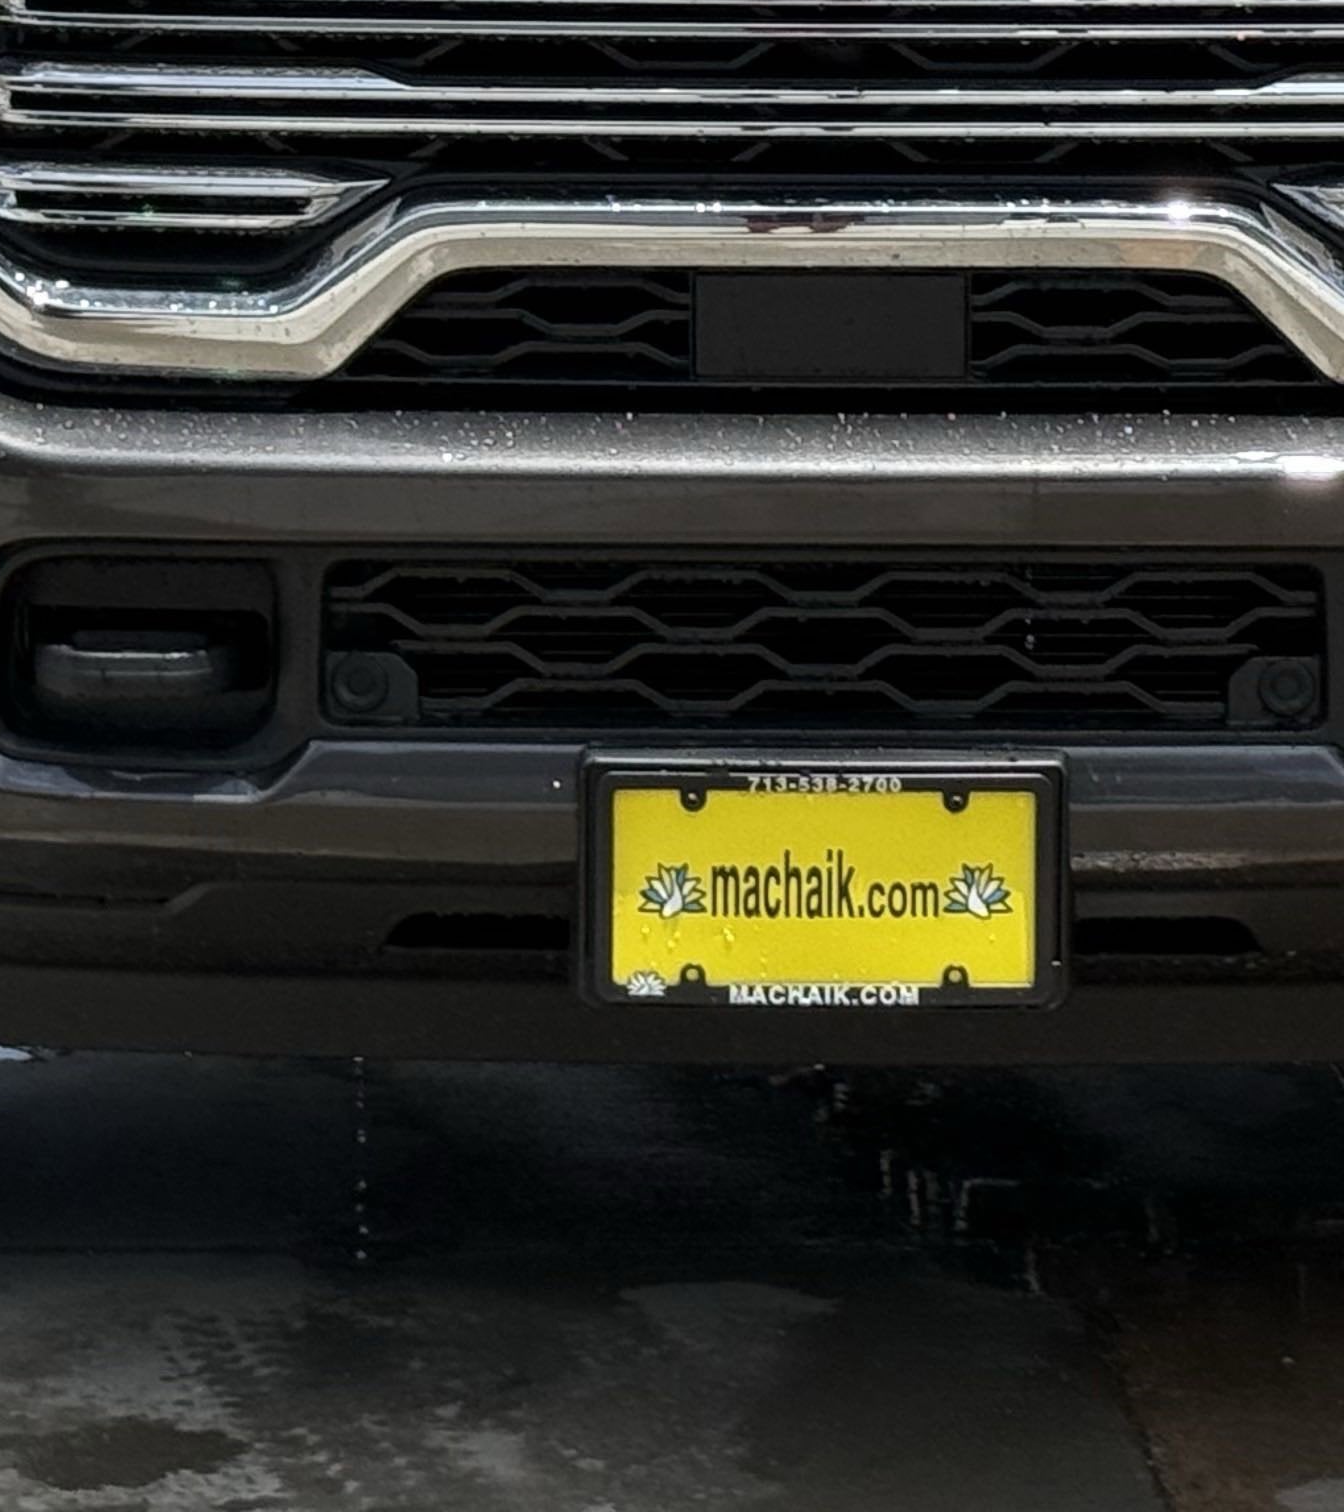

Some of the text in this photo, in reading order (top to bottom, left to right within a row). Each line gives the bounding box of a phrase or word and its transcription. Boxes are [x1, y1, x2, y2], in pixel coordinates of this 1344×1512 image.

[746, 776, 903, 793] 713-538-2700
[710, 849, 940, 919] machaik.com
[728, 983, 920, 1006] MACHAIK.COM
